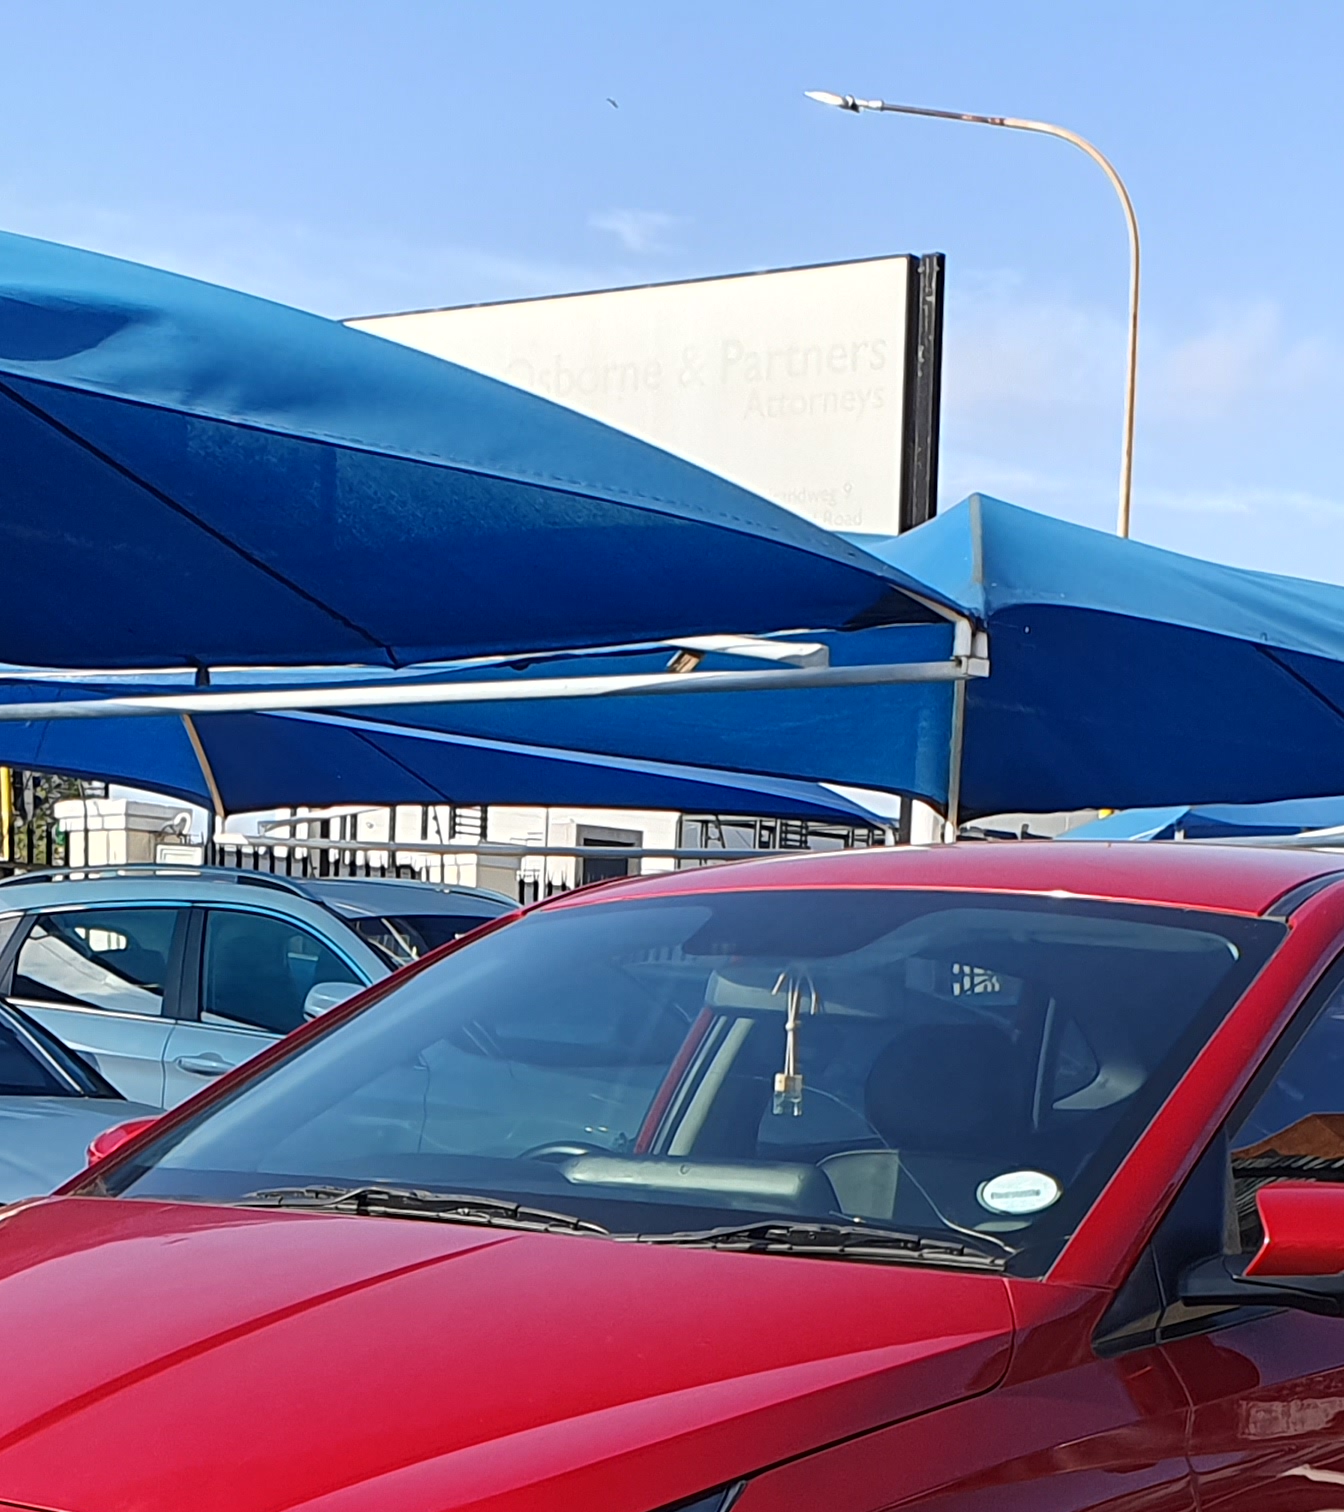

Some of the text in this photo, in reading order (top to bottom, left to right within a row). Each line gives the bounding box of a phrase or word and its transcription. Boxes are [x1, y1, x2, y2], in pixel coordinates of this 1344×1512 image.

[506, 338, 887, 397] Osborne & Partners
[743, 385, 886, 421] Attorneys
